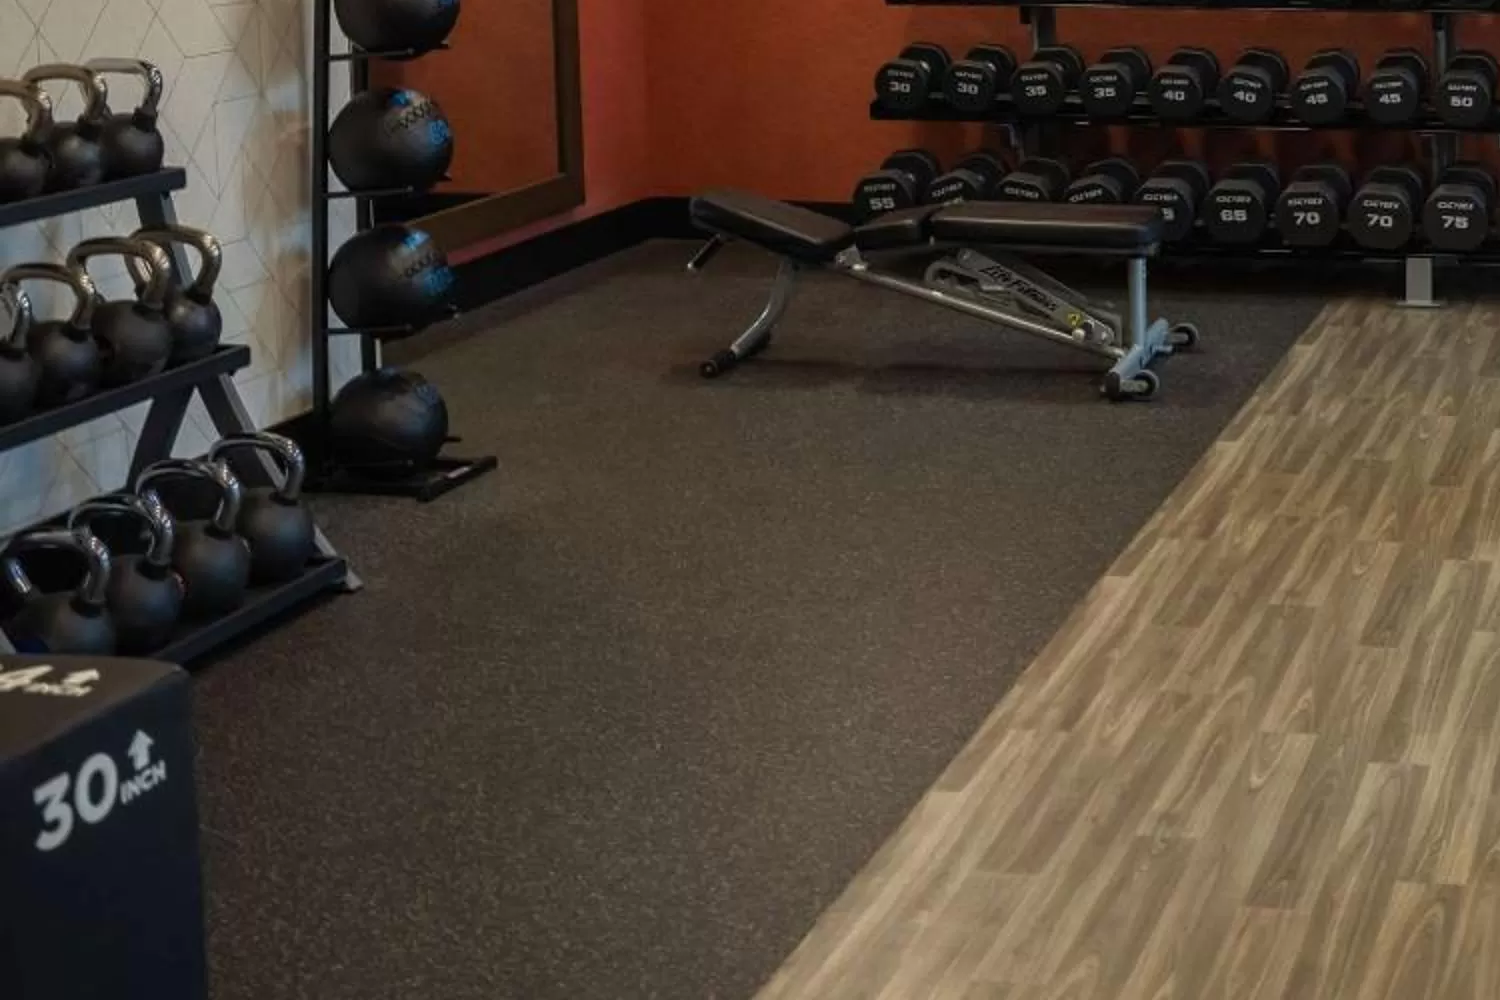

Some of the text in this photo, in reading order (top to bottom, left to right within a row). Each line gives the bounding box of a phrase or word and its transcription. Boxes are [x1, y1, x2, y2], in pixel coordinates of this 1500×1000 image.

[889, 81, 911, 94] 30
[956, 82, 978, 96] 30
[1025, 84, 1047, 97] 35
[1094, 85, 1116, 98] 35
[1164, 90, 1185, 102] 40
[1233, 91, 1256, 104] 40
[1306, 93, 1328, 105] 45
[1379, 93, 1401, 105] 45
[1451, 95, 1473, 108] 50
[870, 197, 895, 210] 55
[1220, 208, 1247, 222] 65
[1293, 211, 1321, 225] 70
[1366, 213, 1394, 228] 70
[1441, 215, 1469, 230] 75
[33, 752, 167, 851] 30 INCH
